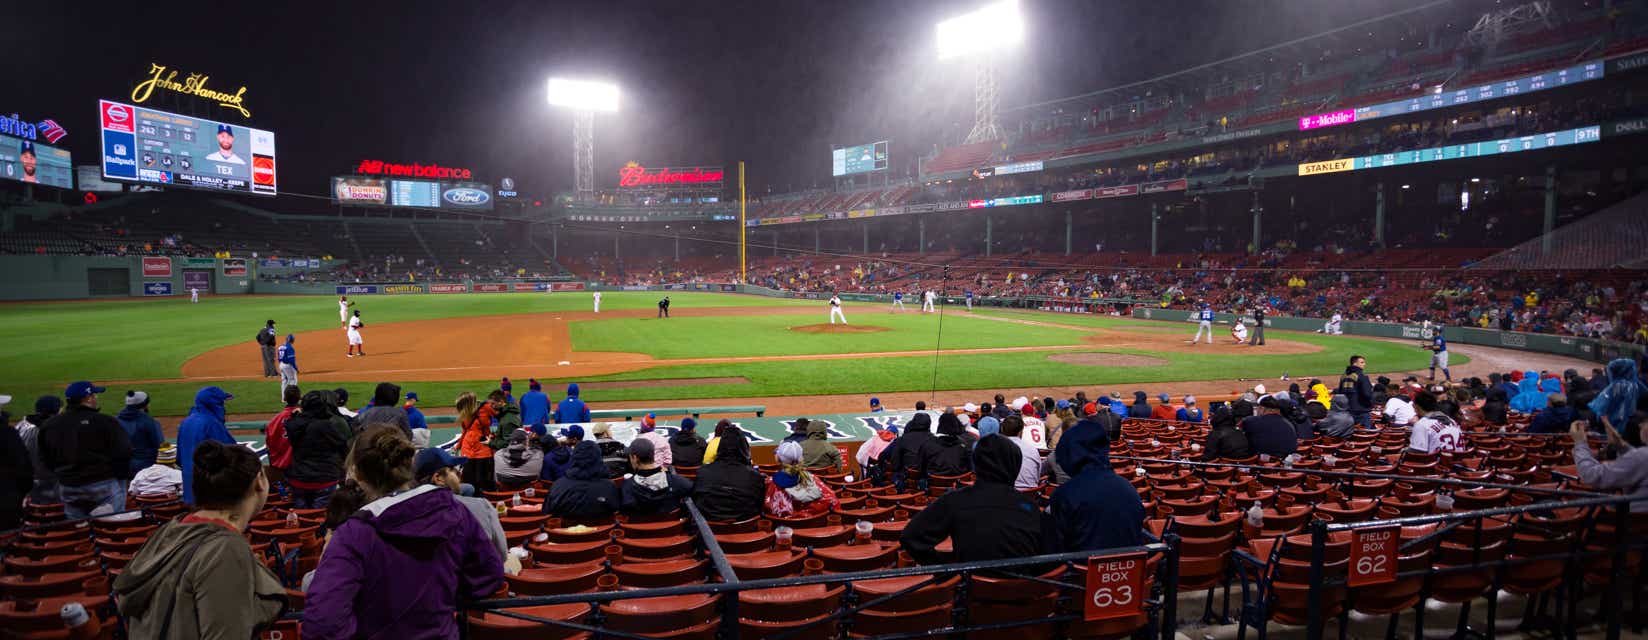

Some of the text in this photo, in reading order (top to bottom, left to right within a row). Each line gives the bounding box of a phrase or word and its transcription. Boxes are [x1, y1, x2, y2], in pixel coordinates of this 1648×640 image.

[132, 63, 250, 118] John Hancock
[1578, 129, 1599, 140] 9TH
[1501, 144, 1507, 152] 0
[1525, 141, 1531, 150] 0
[1548, 138, 1554, 146] 0
[106, 155, 136, 167] Ballpark
[7, 164, 13, 176] 0
[216, 165, 233, 175] TEX
[384, 163, 412, 176] new
[413, 162, 471, 179] balance
[1304, 161, 1347, 174] STANLEY
[619, 166, 724, 187] Budweiser
[452, 190, 480, 203] Ford
[1031, 428, 1041, 443] 6
[1360, 531, 1391, 543] FIELD
[1363, 542, 1386, 552] BOX
[1098, 560, 1135, 572] FIELD
[1357, 554, 1387, 575] 62
[1102, 572, 1129, 583] BOX
[1094, 585, 1132, 607] 63
